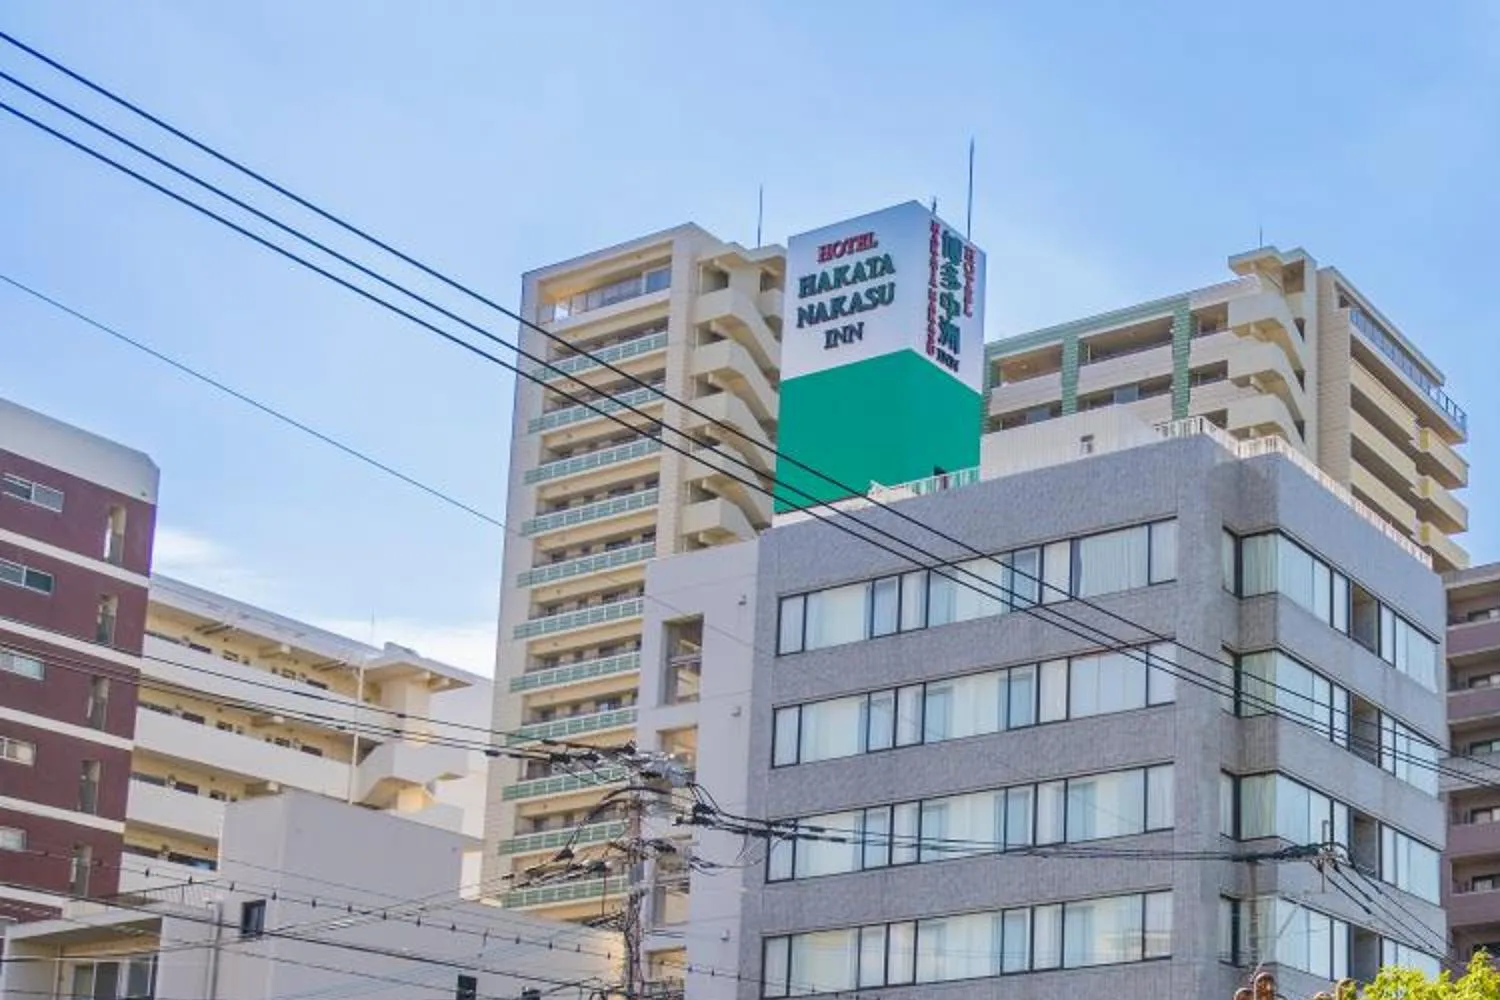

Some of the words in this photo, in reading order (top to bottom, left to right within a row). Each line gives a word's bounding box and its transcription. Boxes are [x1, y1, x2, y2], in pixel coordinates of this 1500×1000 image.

[818, 231, 878, 264] HOTEL
[798, 253, 896, 299] HAKATA
[796, 282, 896, 328] NAKASU
[824, 321, 865, 349] INN
